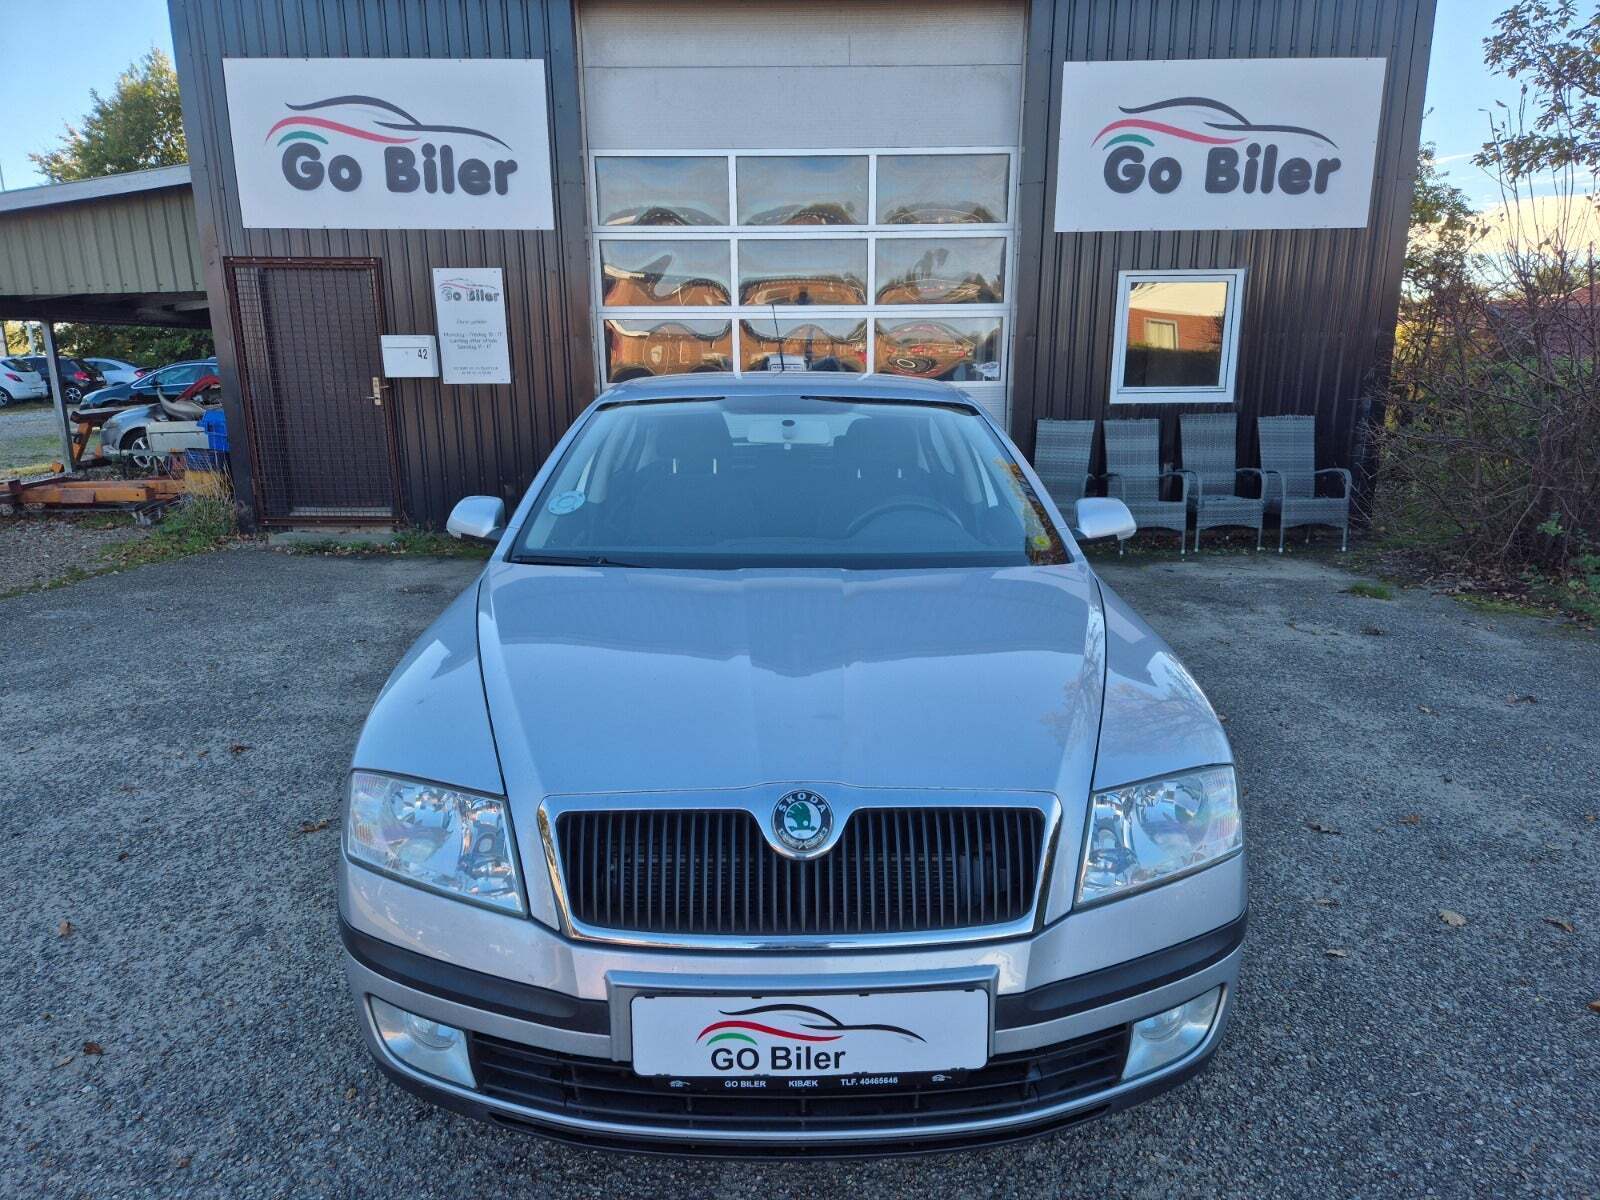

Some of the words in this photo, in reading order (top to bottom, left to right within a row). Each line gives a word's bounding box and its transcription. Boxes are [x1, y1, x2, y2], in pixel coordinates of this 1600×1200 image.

[281, 142, 362, 192] Go
[384, 142, 518, 195] Biler
[1103, 145, 1182, 194] Go
[1204, 142, 1341, 195] Biler
[465, 288, 500, 302] Biler
[417, 348, 428, 360] 42
[710, 1047, 760, 1071] GO
[771, 1046, 846, 1071] Biler
[724, 1080, 738, 1088] GO
[740, 1080, 767, 1088] BILER
[788, 1079, 818, 1087] KIBÆK
[840, 1078, 858, 1086] TLF.
